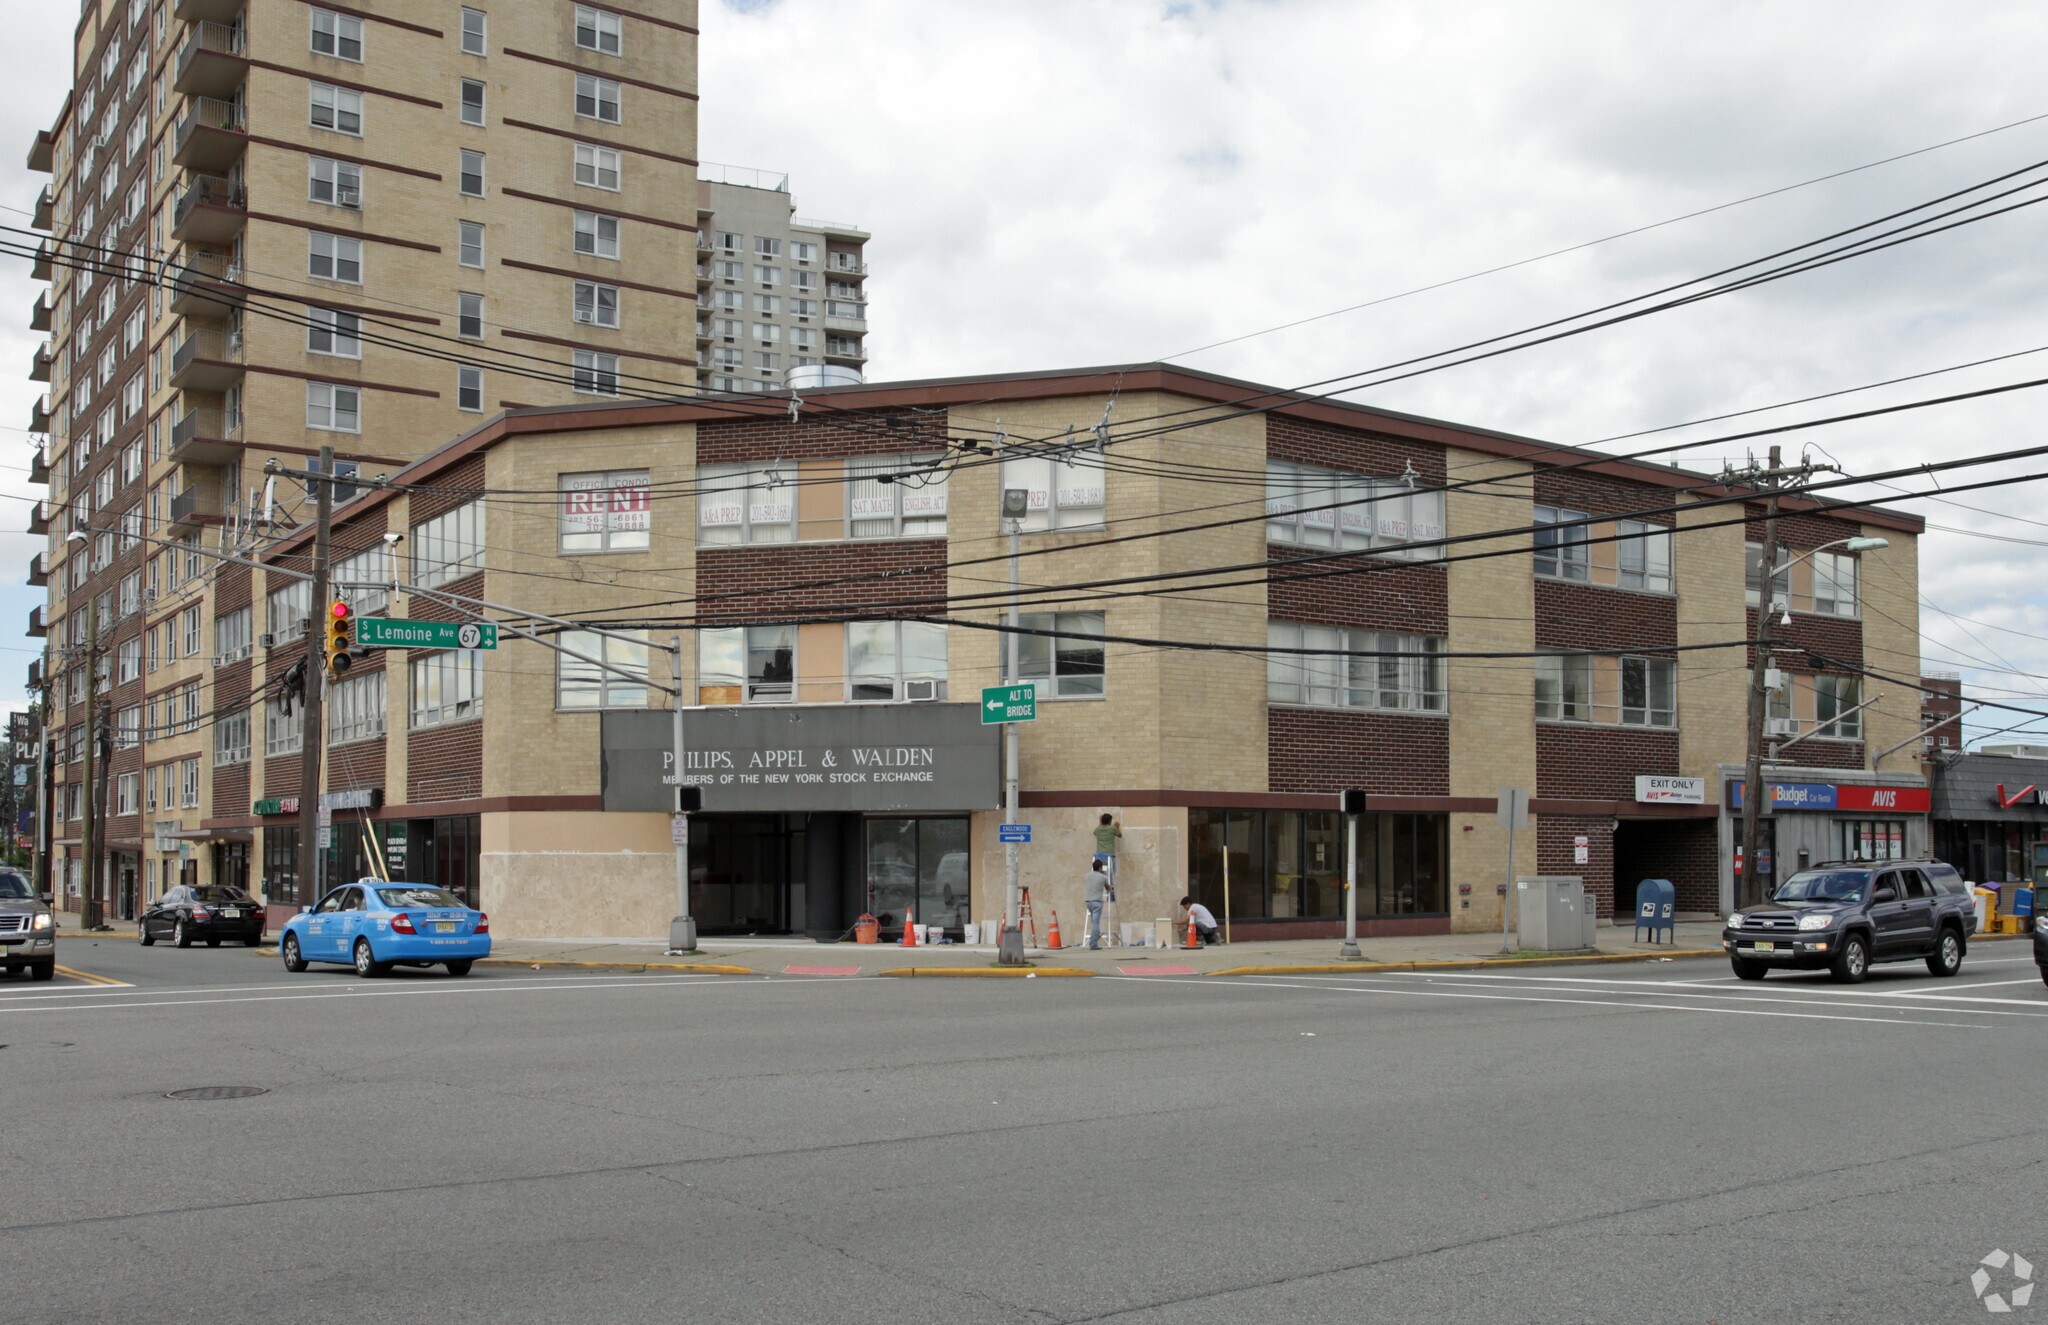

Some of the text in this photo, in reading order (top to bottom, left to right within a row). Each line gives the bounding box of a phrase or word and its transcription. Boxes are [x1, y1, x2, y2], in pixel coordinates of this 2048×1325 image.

[573, 478, 649, 489] OFFICE CONDO
[571, 488, 649, 512] RENT
[871, 499, 893, 513] MATH
[933, 496, 944, 510] ACT
[703, 507, 741, 524] A&A PREP
[1317, 511, 1334, 523] MATH
[1379, 520, 1407, 537] A&A PREP
[1425, 525, 1440, 538] MATH
[362, 621, 368, 630] S
[486, 628, 492, 636] N
[377, 625, 454, 641] Lemoine Ave
[462, 630, 477, 643] 67
[1009, 689, 1032, 701] ALT TO
[1007, 704, 1032, 717] BRIDGE
[663, 748, 934, 769] PILIPS, APPEL & WALDEN
[662, 772, 933, 784] MEBERS OF THE NEW YORK STOCK EXCHANGE
[1651, 780, 1694, 788] EXIT ONLY
[1776, 785, 1808, 805] Budget
[1818, 794, 1831, 802] Rental
[1872, 791, 1896, 807] AVIS
